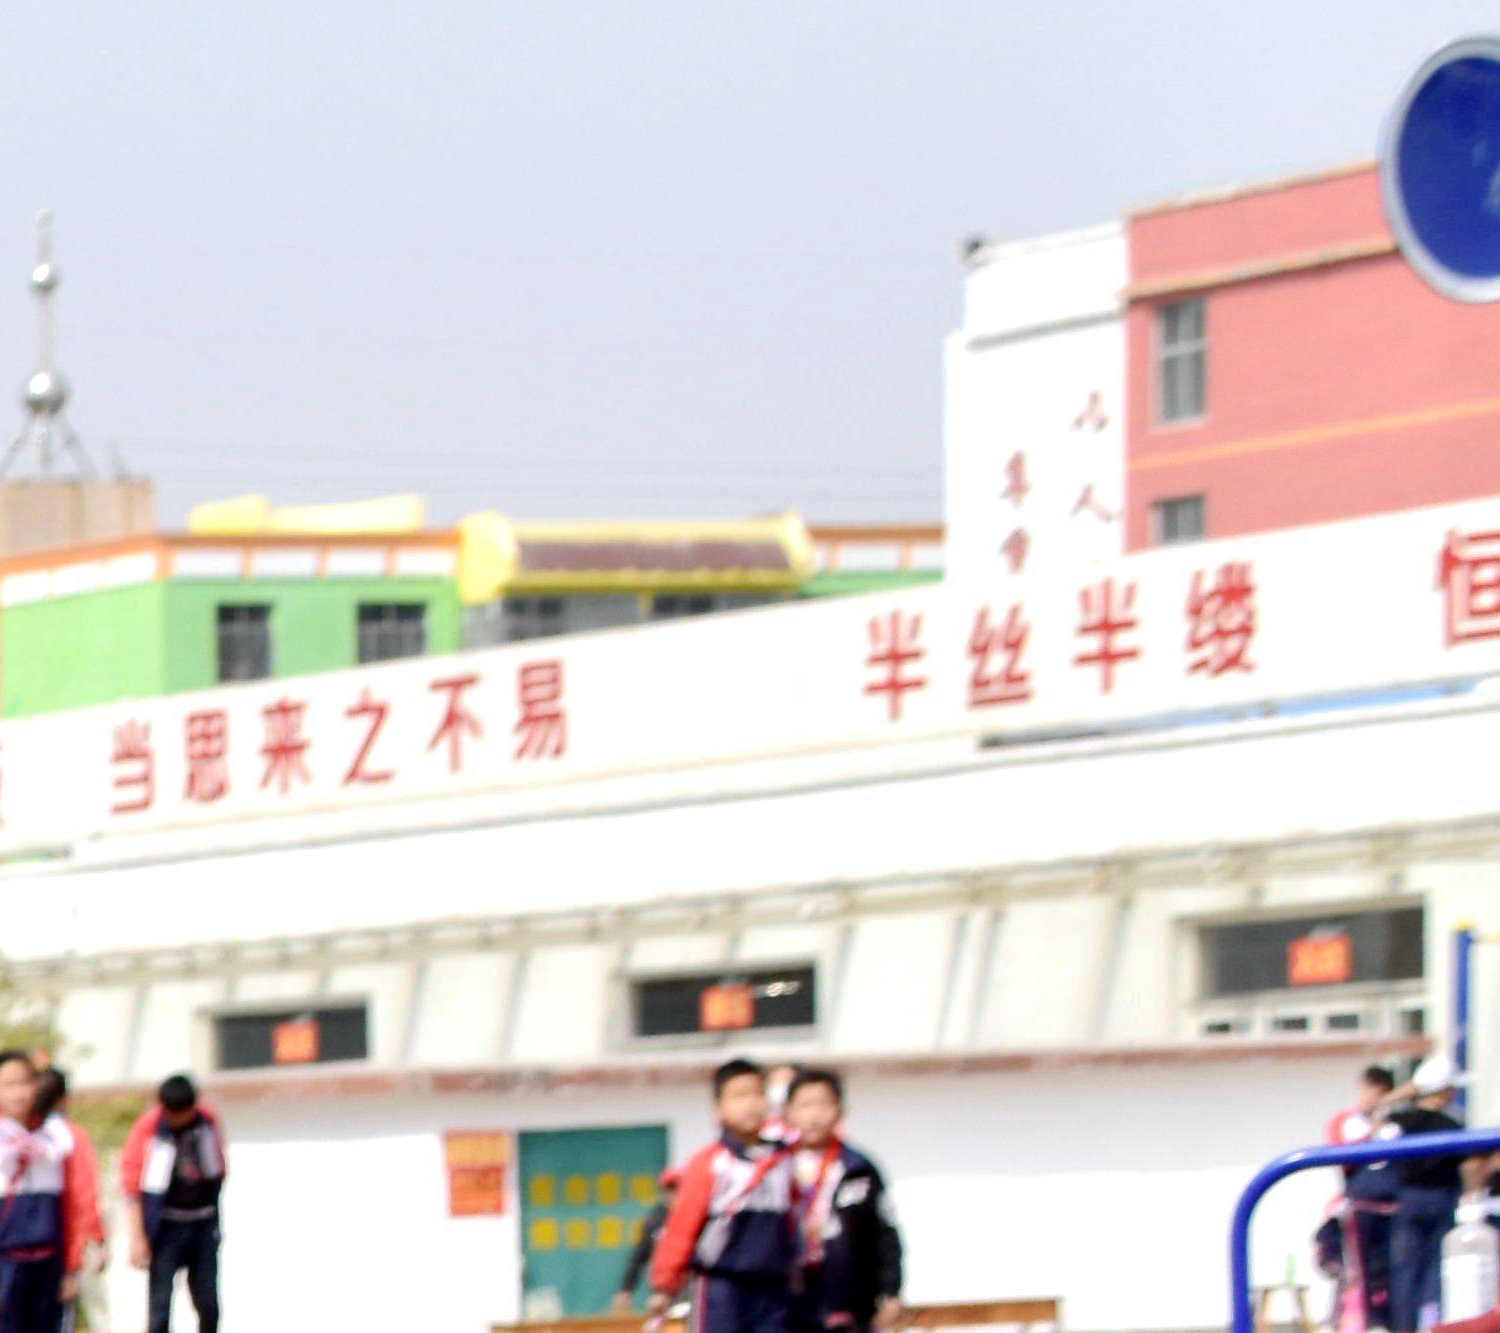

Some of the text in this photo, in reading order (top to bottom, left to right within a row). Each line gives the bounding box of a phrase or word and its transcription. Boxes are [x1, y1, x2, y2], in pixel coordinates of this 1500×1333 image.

[111, 658, 569, 815] 当思来之不易
[863, 556, 1258, 722] 半丝半缕
